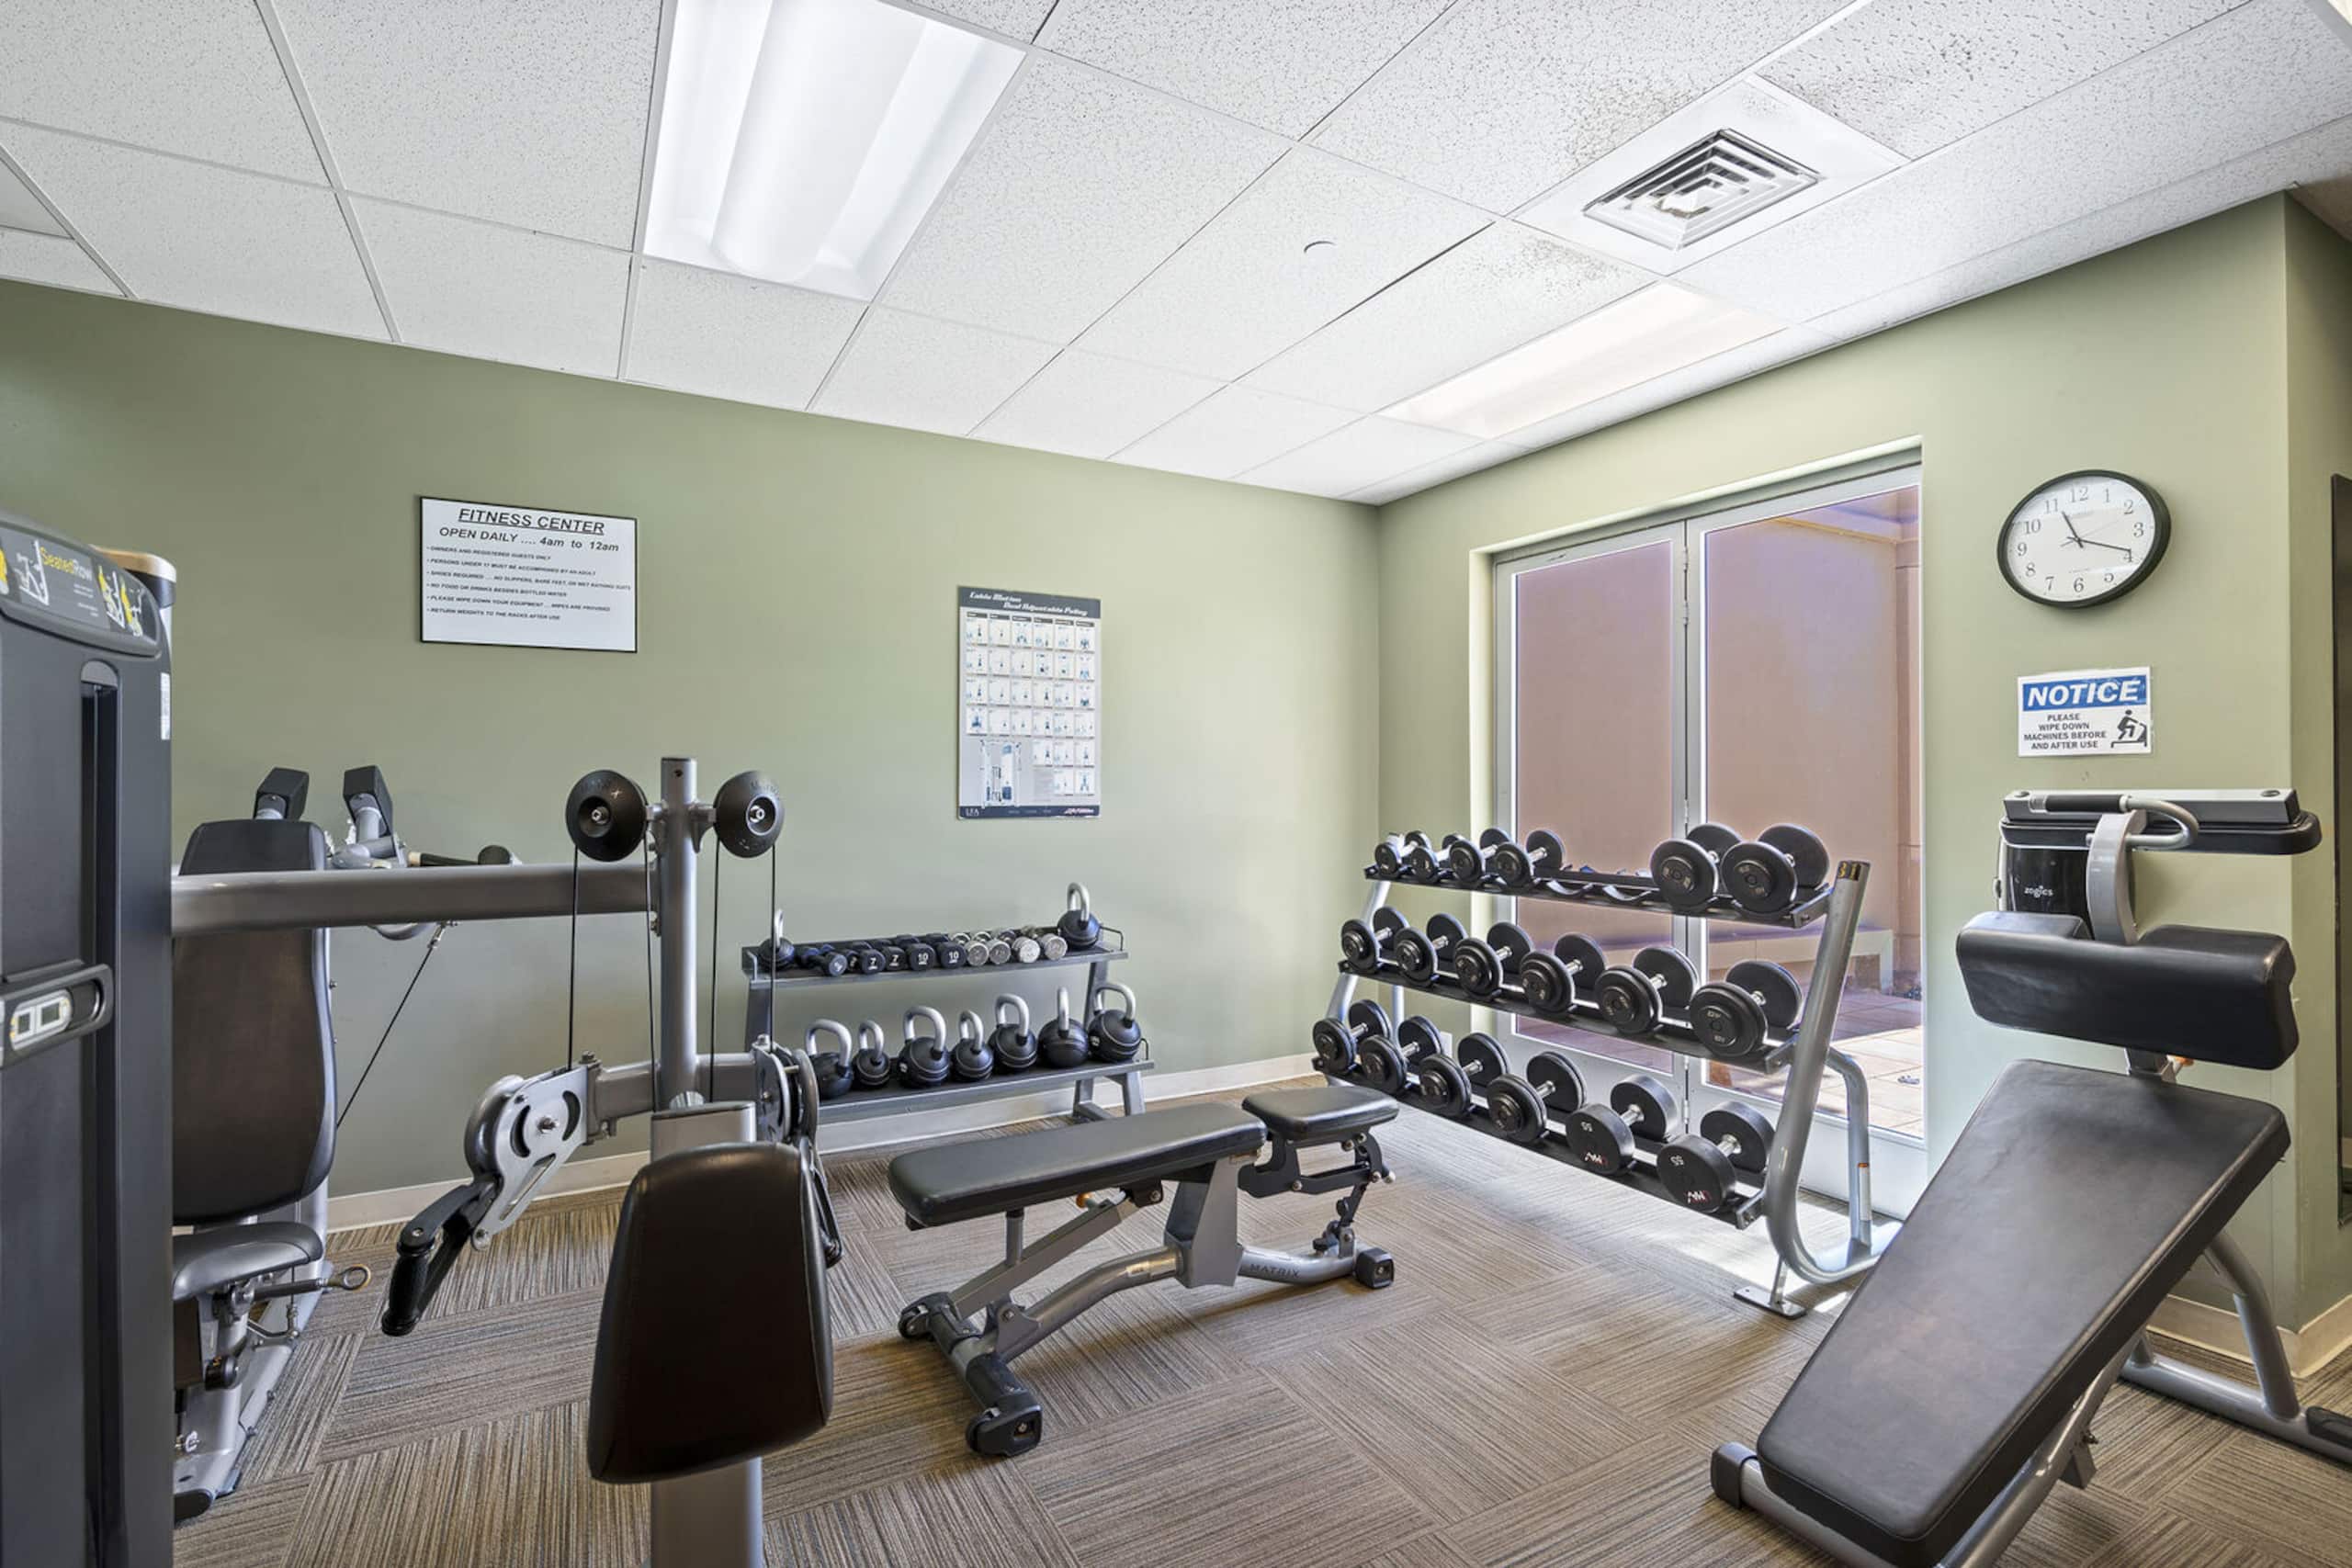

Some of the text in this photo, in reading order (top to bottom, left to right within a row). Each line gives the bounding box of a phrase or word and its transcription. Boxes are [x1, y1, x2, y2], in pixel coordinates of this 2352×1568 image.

[2071, 487, 2088, 502] 12
[2105, 489, 2110, 502] 1
[2045, 499, 2058, 513] 11
[2124, 501, 2134, 515] 2
[458, 508, 605, 535] FITNESS CENTER
[2024, 519, 2041, 535] 10
[2133, 522, 2144, 537] 3
[439, 527, 477, 539] OPEN
[480, 531, 518, 542] DAILY
[540, 536, 564, 547] 4am
[571, 540, 582, 548] to
[591, 541, 619, 551] 12am
[2018, 542, 2027, 557] 9
[2025, 563, 2036, 577] 8
[2045, 576, 2054, 591] 7
[2074, 578, 2084, 592] 6
[992, 592, 1022, 603] Motion
[1003, 602, 1088, 616] Dual Adjustable Pulley
[2028, 680, 2141, 706] NOTICE
[2047, 713, 2080, 721] PLEASE
[2039, 722, 2089, 731] WIPE DOWN
[2024, 731, 2107, 741] MACHINES BEFORE
[2031, 739, 2098, 750] AND AFTER USE
[2024, 885, 2053, 898] zogics
[1250, 1263, 1301, 1278] MATRIX
